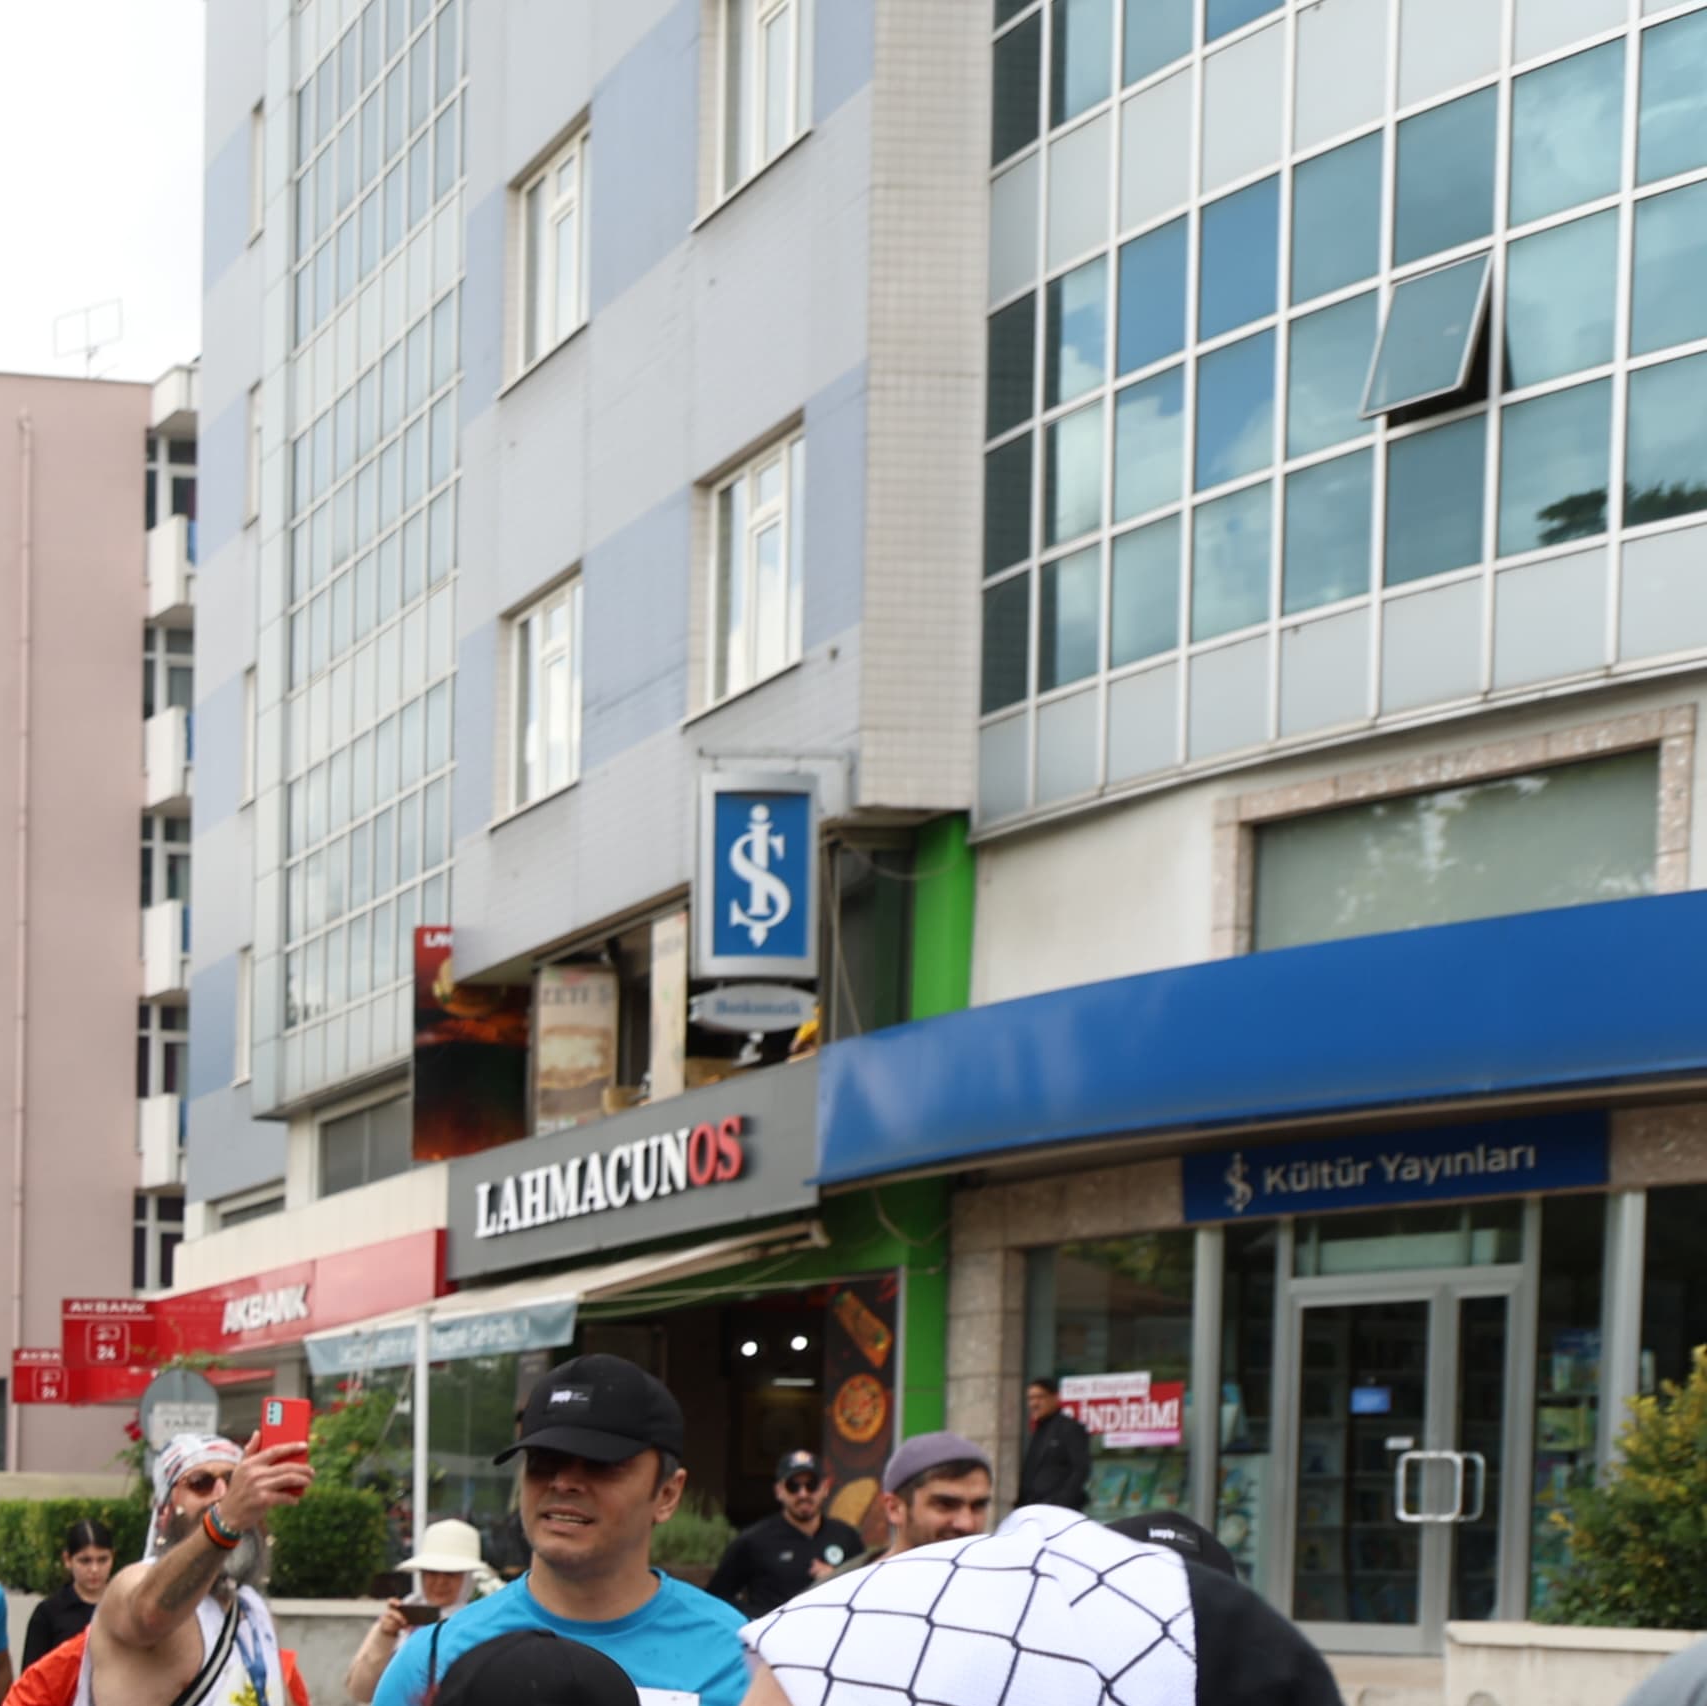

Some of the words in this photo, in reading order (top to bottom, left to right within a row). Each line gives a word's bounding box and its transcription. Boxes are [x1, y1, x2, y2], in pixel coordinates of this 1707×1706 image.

[474, 1114, 744, 1239] LAHMACUNOS
[1264, 1155, 1372, 1195] Kültür
[1378, 1142, 1537, 1186] Yayınları
[68, 1301, 148, 1314] AKBANK
[220, 1283, 310, 1336] AKBANK
[19, 1351, 61, 1362] AKBA
